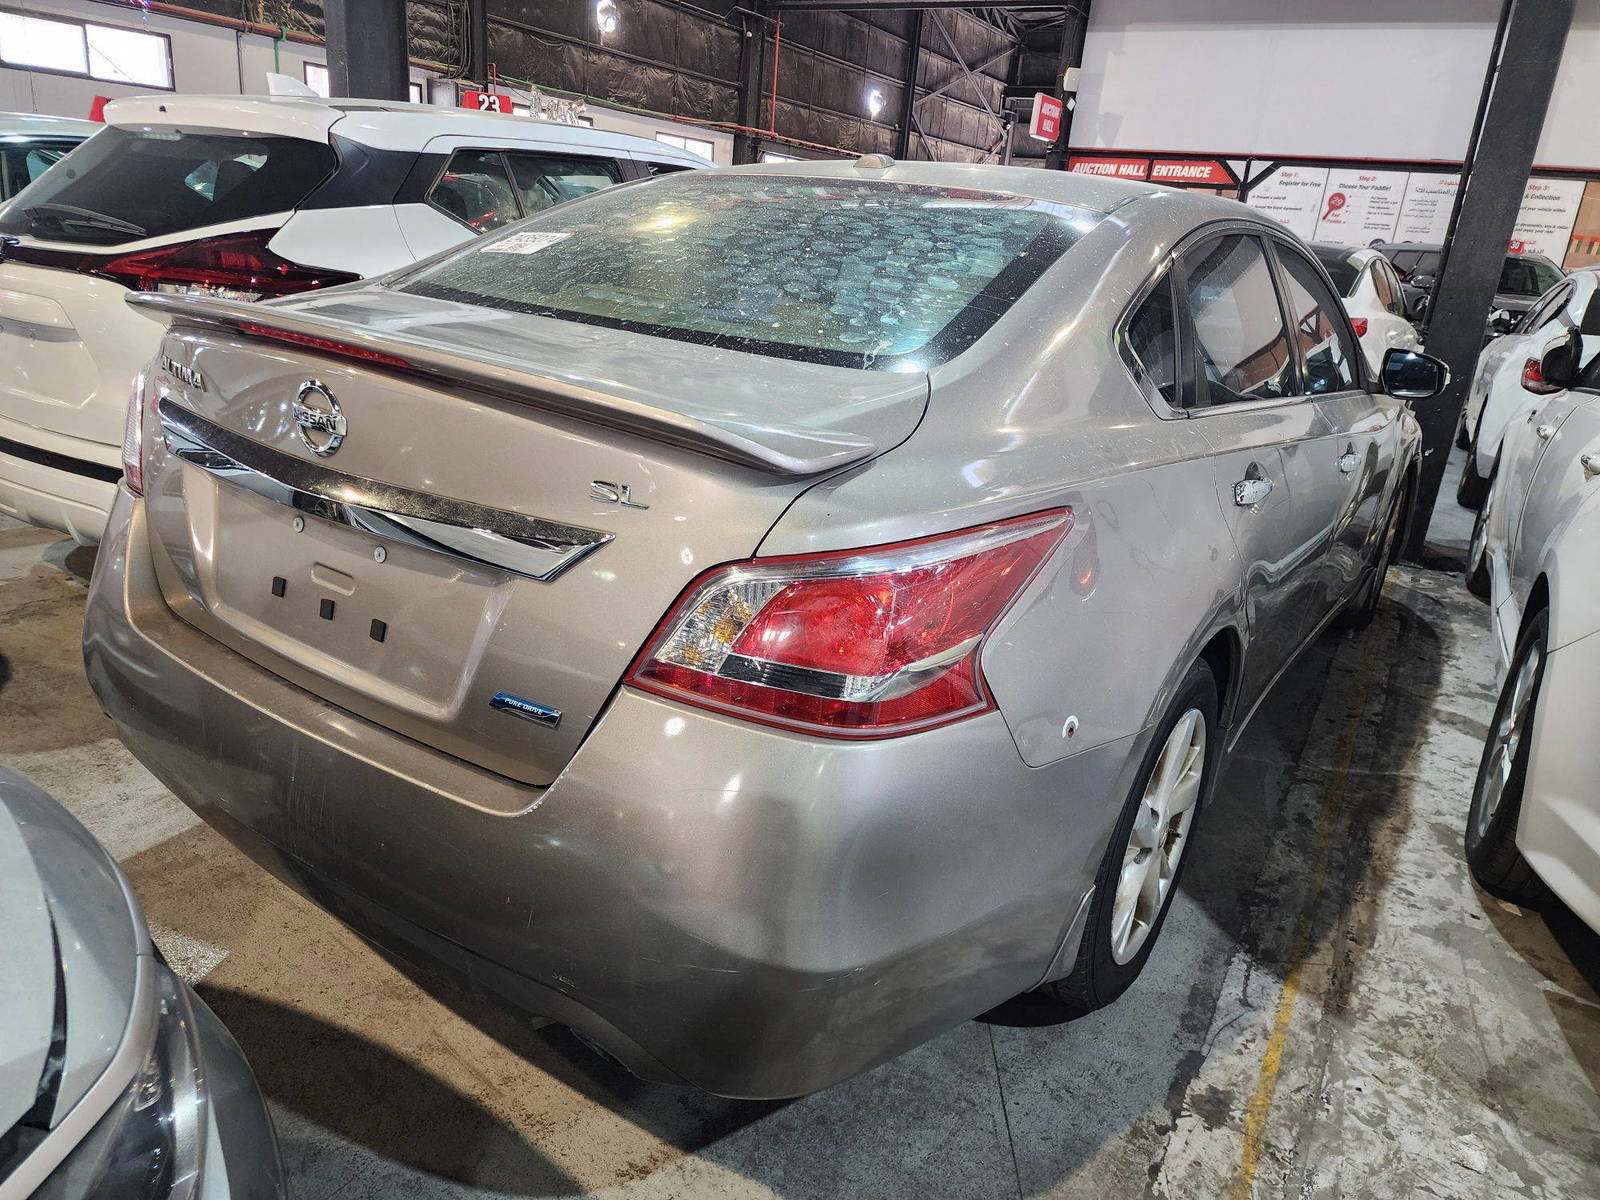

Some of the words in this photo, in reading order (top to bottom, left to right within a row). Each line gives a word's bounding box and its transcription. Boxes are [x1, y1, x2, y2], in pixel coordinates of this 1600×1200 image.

[479, 94, 500, 113] 23
[1041, 102, 1060, 119] AUCTION
[1042, 118, 1054, 133] HALL
[1071, 162, 1118, 175] AUCTION
[1118, 164, 1145, 176] HALL
[1152, 165, 1213, 178] ENTRANCE
[1527, 184, 1543, 192] Step
[1530, 193, 1561, 201] Collection
[162, 355, 207, 392] ALTIMA
[293, 405, 337, 431] NISSAN
[590, 480, 650, 510] SL
[504, 697, 522, 708] PURE
[522, 703, 543, 715] DRIVE
